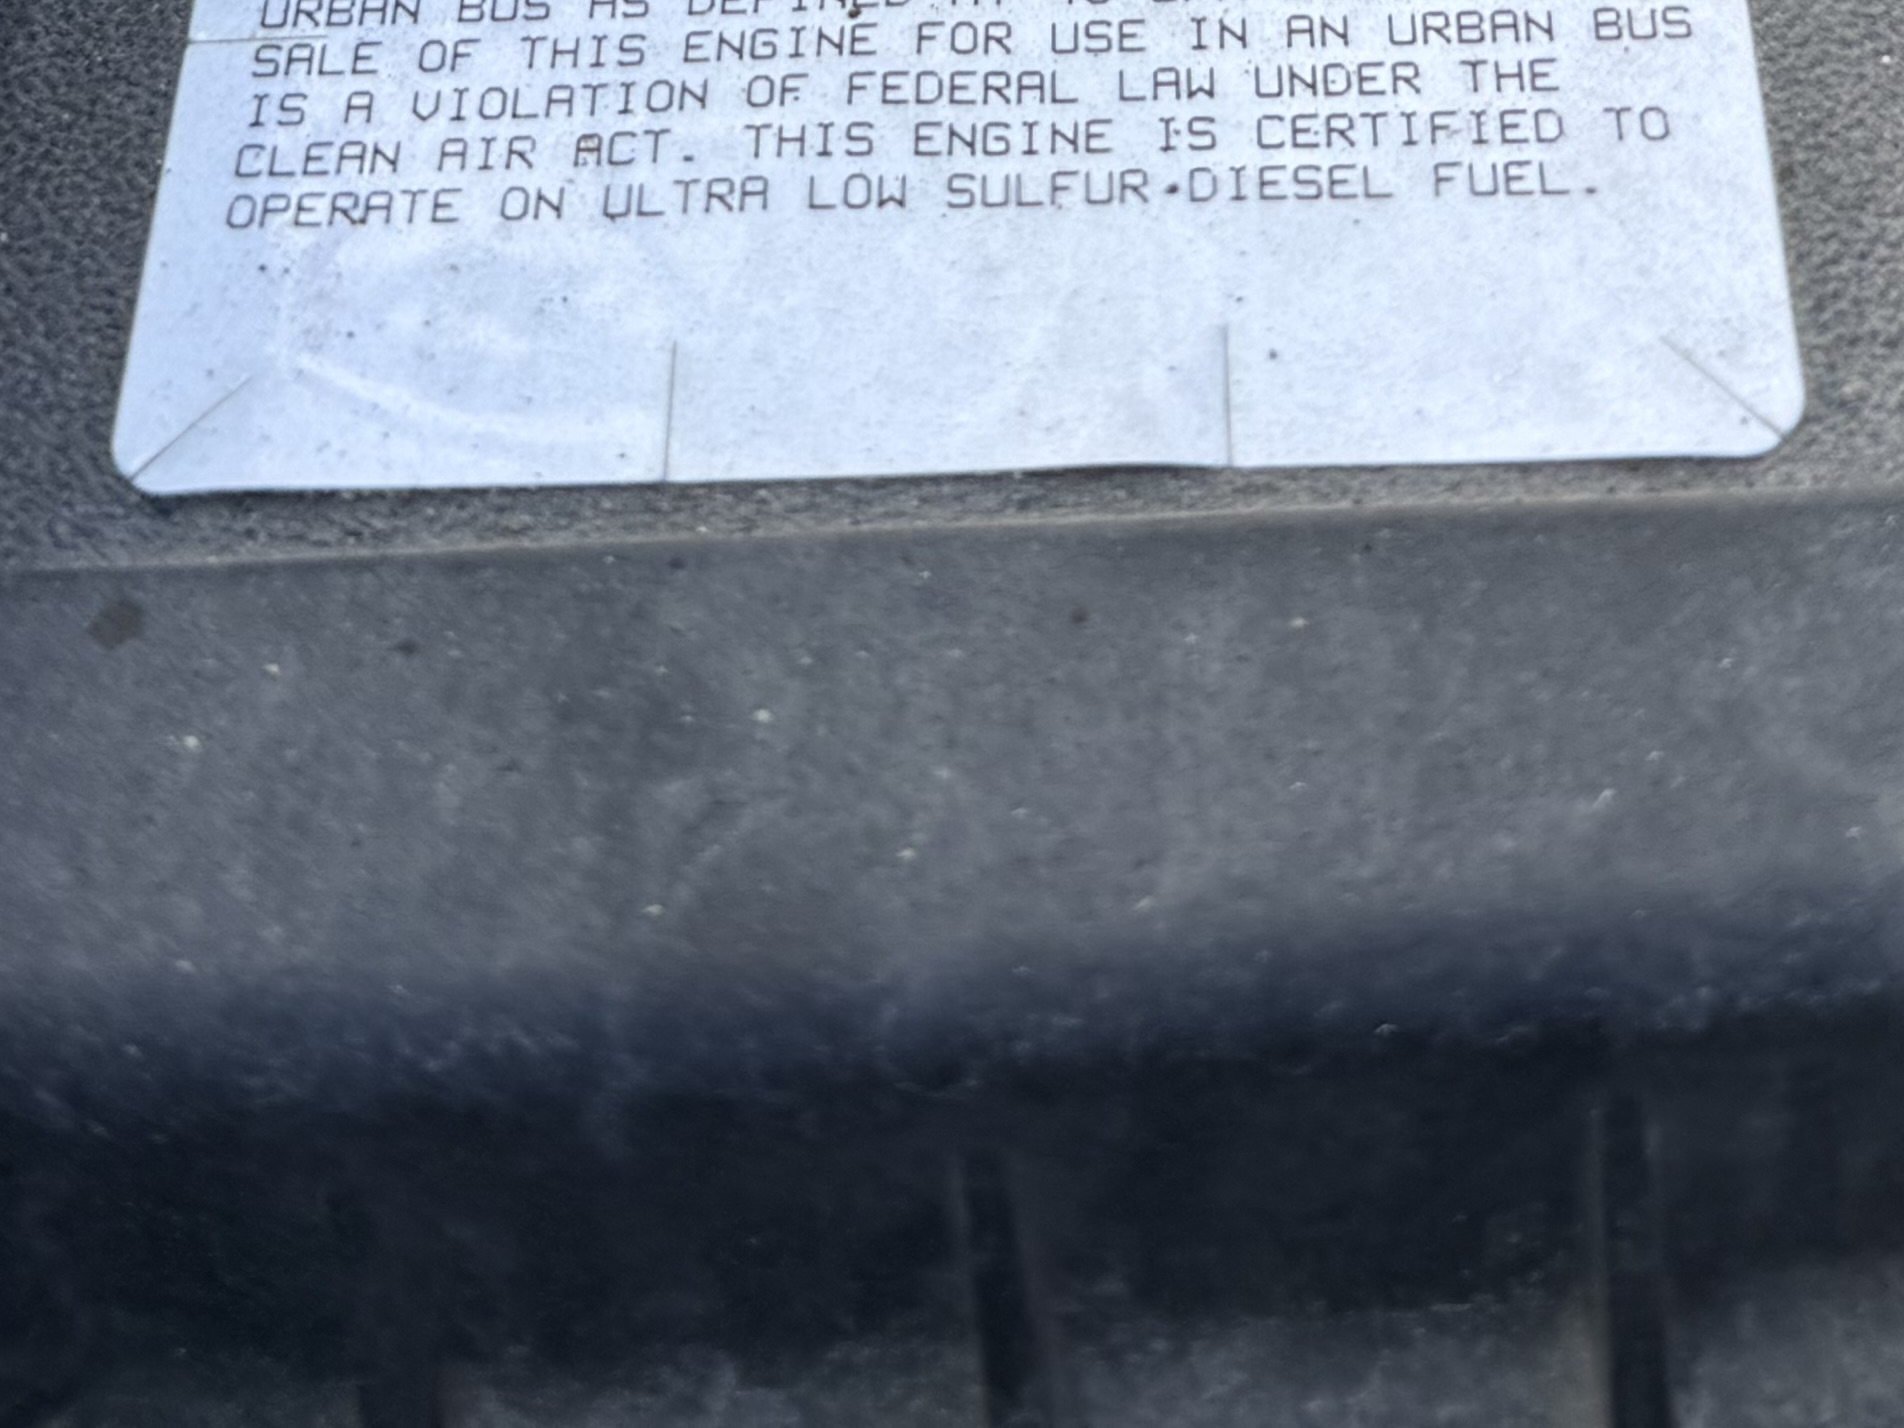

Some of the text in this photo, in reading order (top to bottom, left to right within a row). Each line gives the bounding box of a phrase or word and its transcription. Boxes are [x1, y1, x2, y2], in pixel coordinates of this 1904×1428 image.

[252, 6, 1692, 78] SALE OF THIS ENGINE FOR USE IN AN URBAN BUS
[248, 58, 1559, 128] IS A VIOLATION OF FEDERAL LAW UNDER THE
[234, 106, 1671, 178] CLEAN AIR ACT. THIS ENGINE IS CERTIFIED TO
[226, 160, 1597, 229] OPERATE ON ULTRA LOW SULFUR DIESEL FUEL.
